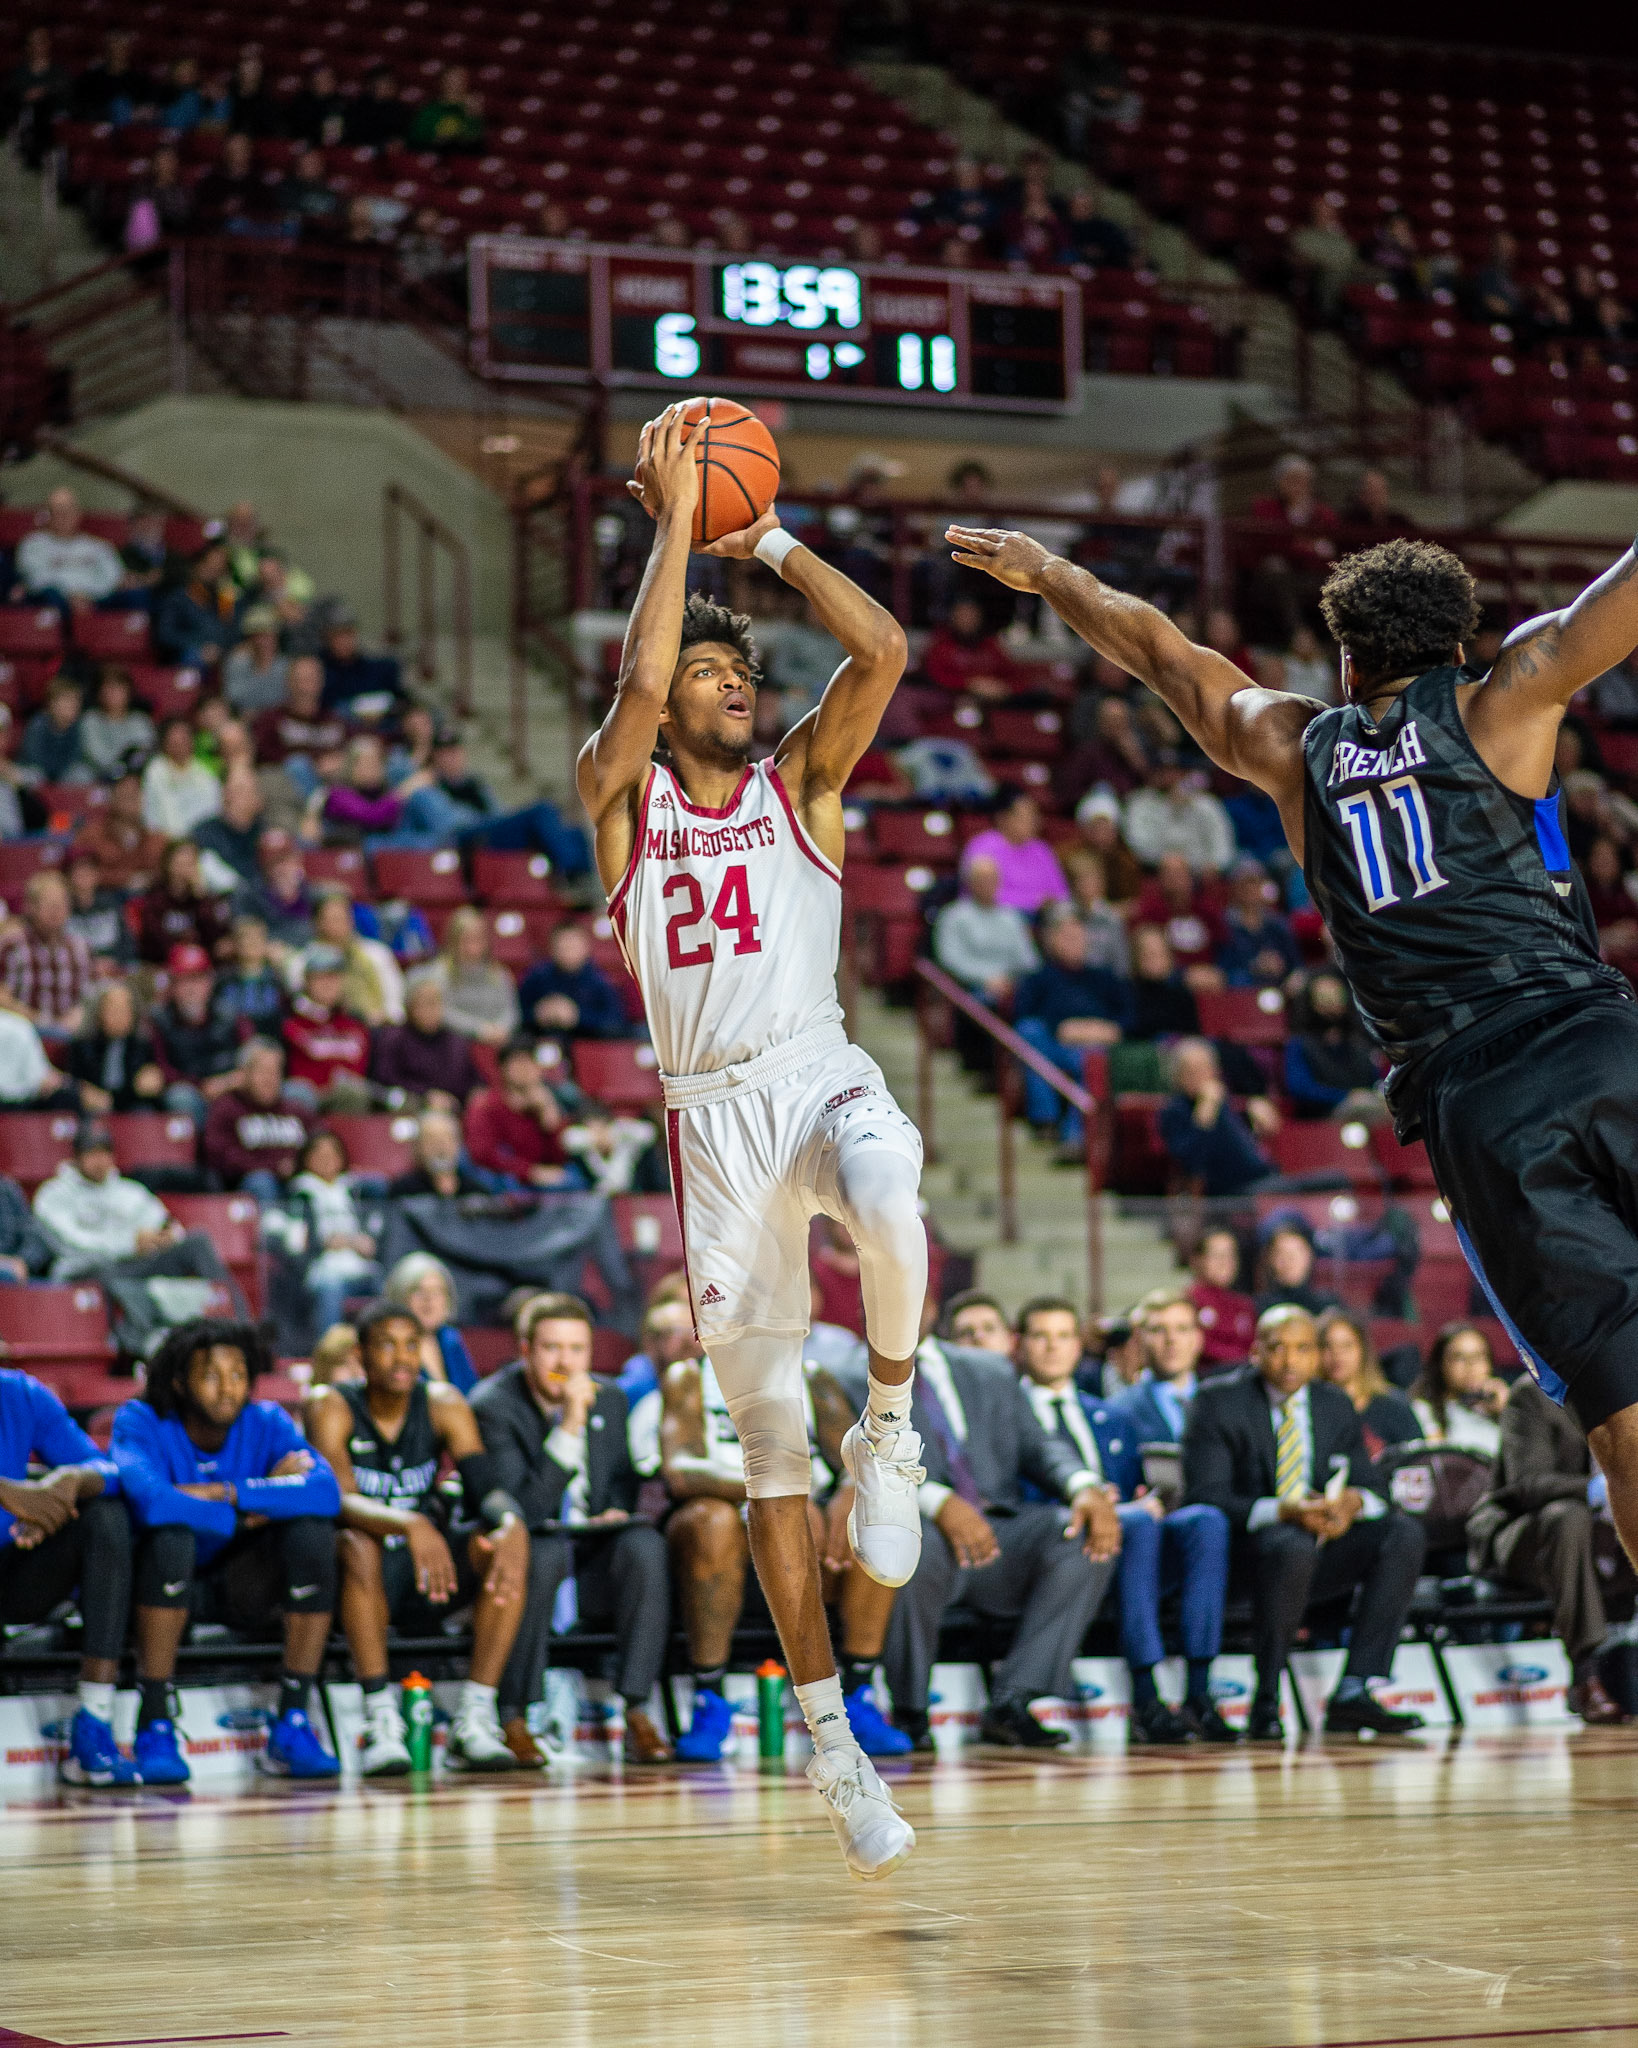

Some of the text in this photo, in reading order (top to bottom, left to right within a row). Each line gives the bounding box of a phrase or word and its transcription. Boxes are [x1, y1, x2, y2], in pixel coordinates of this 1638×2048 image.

[654, 312, 701, 378] 6
[897, 332, 957, 393] 11
[1336, 774, 1450, 914] 11
[662, 865, 762, 970] 24
[700, 1295, 726, 1306] adidas
